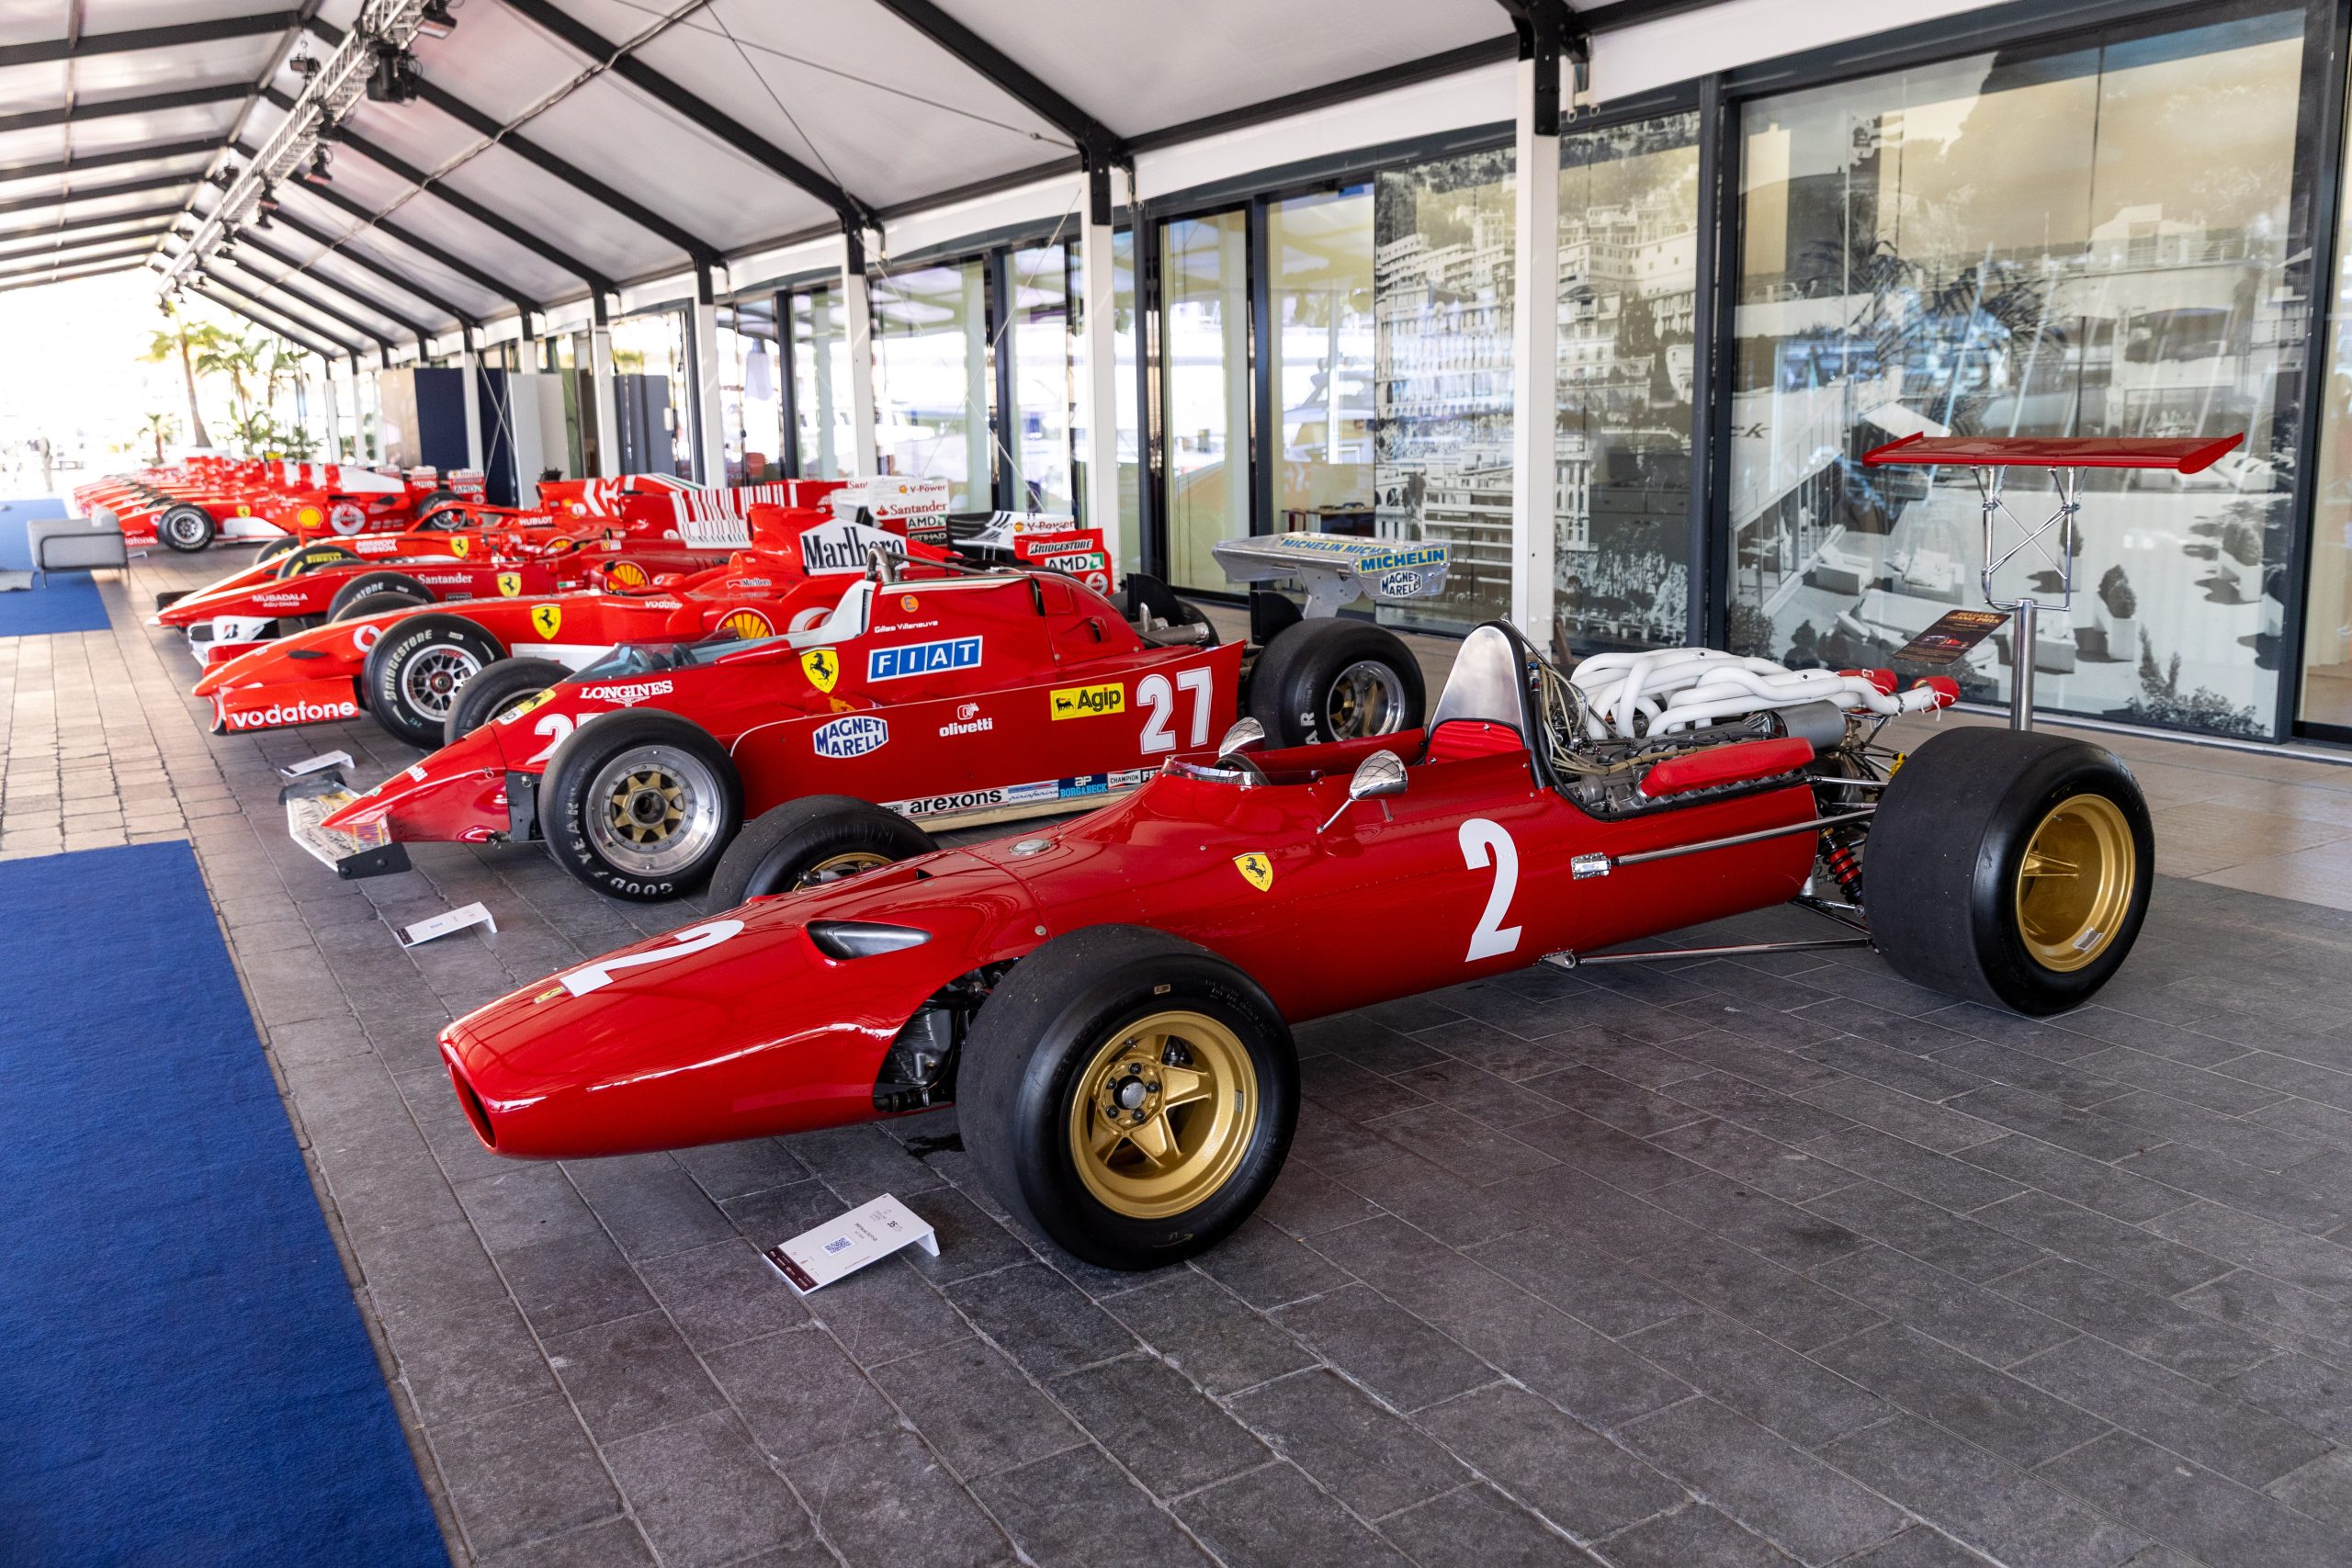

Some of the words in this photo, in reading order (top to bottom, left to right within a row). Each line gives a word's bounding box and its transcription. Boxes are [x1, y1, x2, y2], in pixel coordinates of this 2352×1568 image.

[910, 484, 945, 493] V-Power
[889, 500, 948, 515] Santander
[519, 515, 553, 526] HUBLOT
[909, 515, 937, 528] AMD
[1027, 520, 1075, 532] V-Power
[1029, 539, 1092, 555] BRIDGESTONE
[1281, 539, 1343, 552] MICHELIN
[1047, 556, 1088, 570] AMD
[1361, 548, 1444, 571] MICHELIN
[418, 572, 473, 584] Santander
[252, 593, 309, 604] MUBADALA
[903, 596, 917, 611] E
[874, 625, 897, 633] Gilles
[897, 620, 939, 630] Villeneuve
[384, 629, 433, 702] BRIDGESTONE
[878, 643, 976, 674] FIAT
[580, 680, 674, 700] LONGINES
[1077, 686, 1121, 712] Agip
[232, 700, 356, 728] vodafone
[1136, 666, 1213, 755] 27
[815, 717, 888, 745] MAGNETI
[939, 717, 993, 737] olivetti
[815, 728, 888, 757] MARELLI
[1110, 774, 1139, 784] CHAMPION
[1059, 783, 1108, 798] BORG&BECK
[910, 789, 1002, 814] arexons
[1458, 818, 1522, 963] 2
[560, 919, 745, 998] 2
